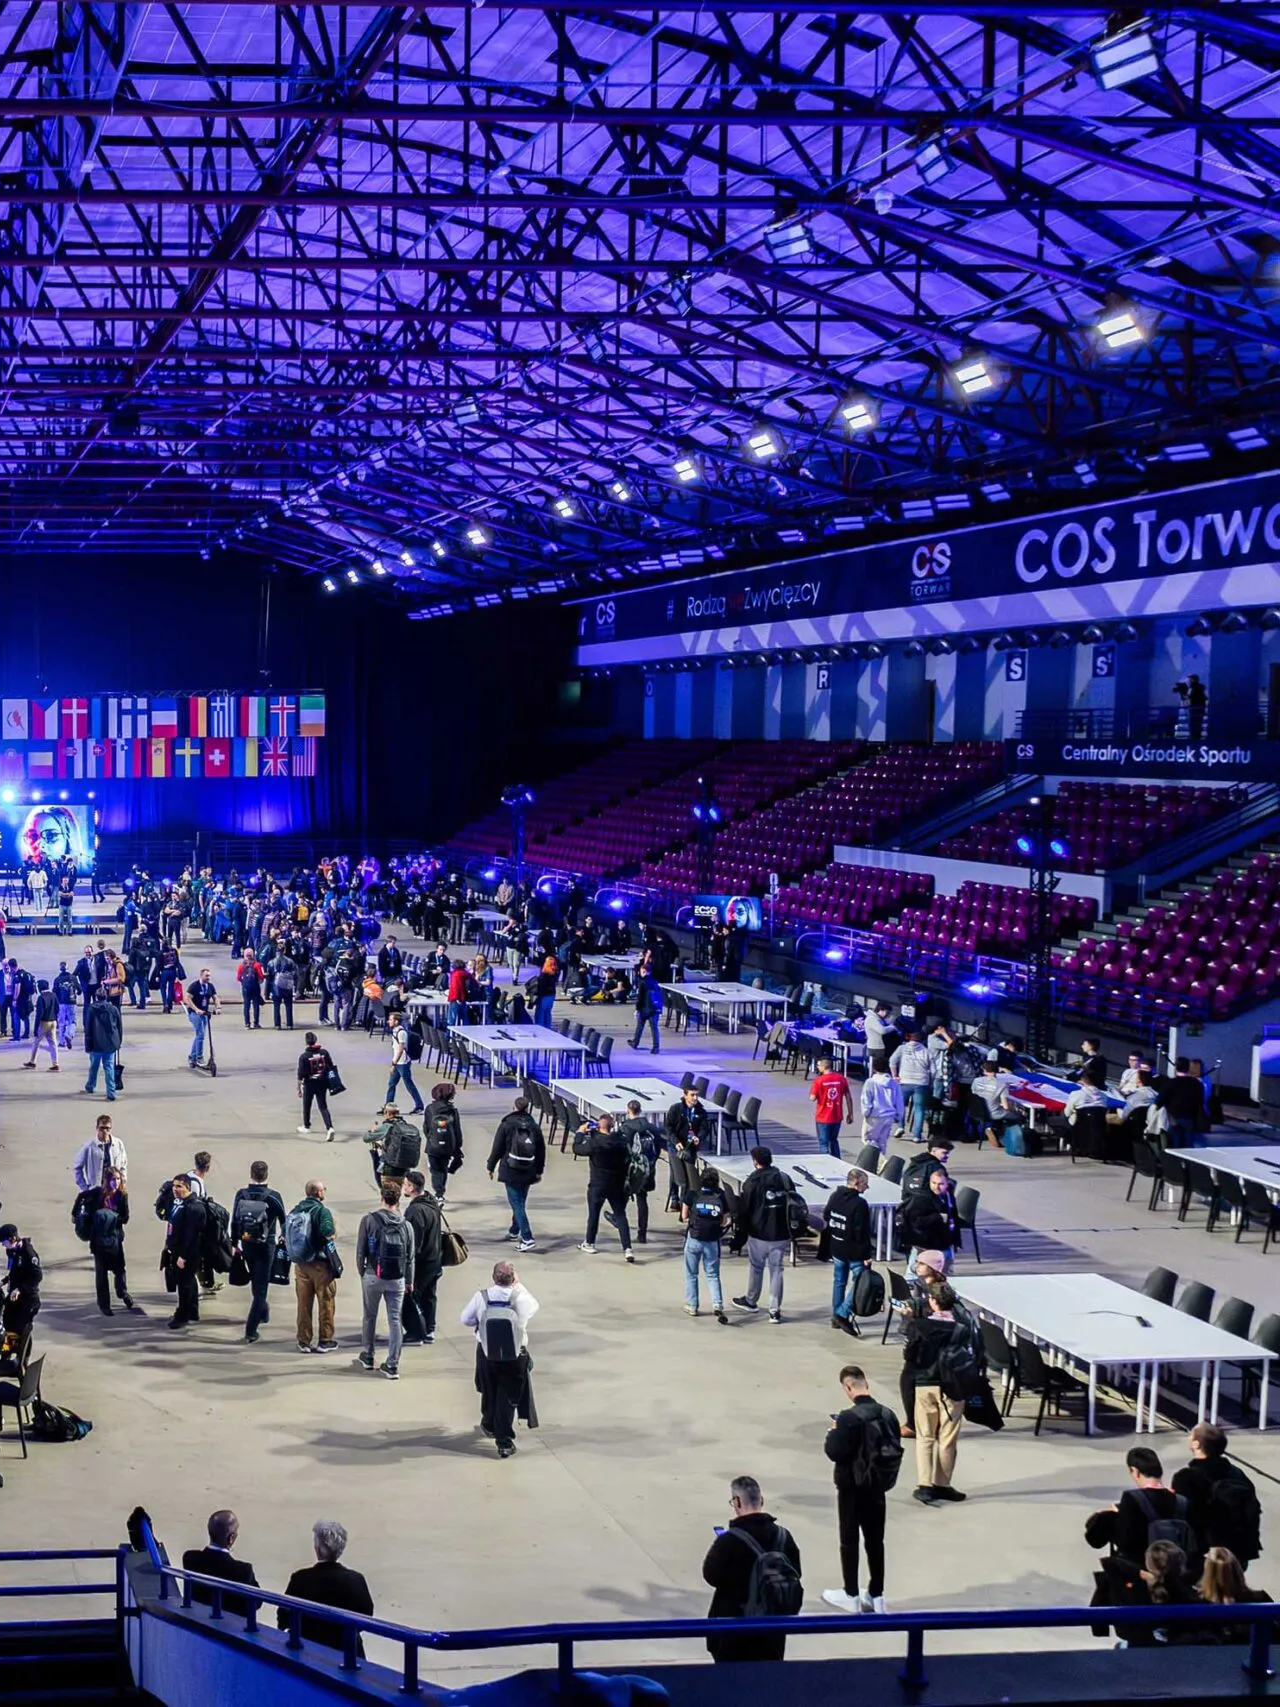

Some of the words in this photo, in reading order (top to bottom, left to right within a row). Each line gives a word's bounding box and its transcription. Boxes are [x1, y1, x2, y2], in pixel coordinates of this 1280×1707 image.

[912, 542, 952, 578] CS
[1015, 517, 1116, 583] COS
[686, 596, 726, 618] Rodzą
[743, 581, 821, 612] Zwycięzcy
[596, 601, 615, 625] CS
[819, 669, 829, 689] R
[1009, 657, 1023, 680] S
[1017, 743, 1034, 757] CS
[1062, 745, 1128, 764] Centralny
[1132, 743, 1195, 763] Ośrodek
[1199, 746, 1251, 766] Sportu
